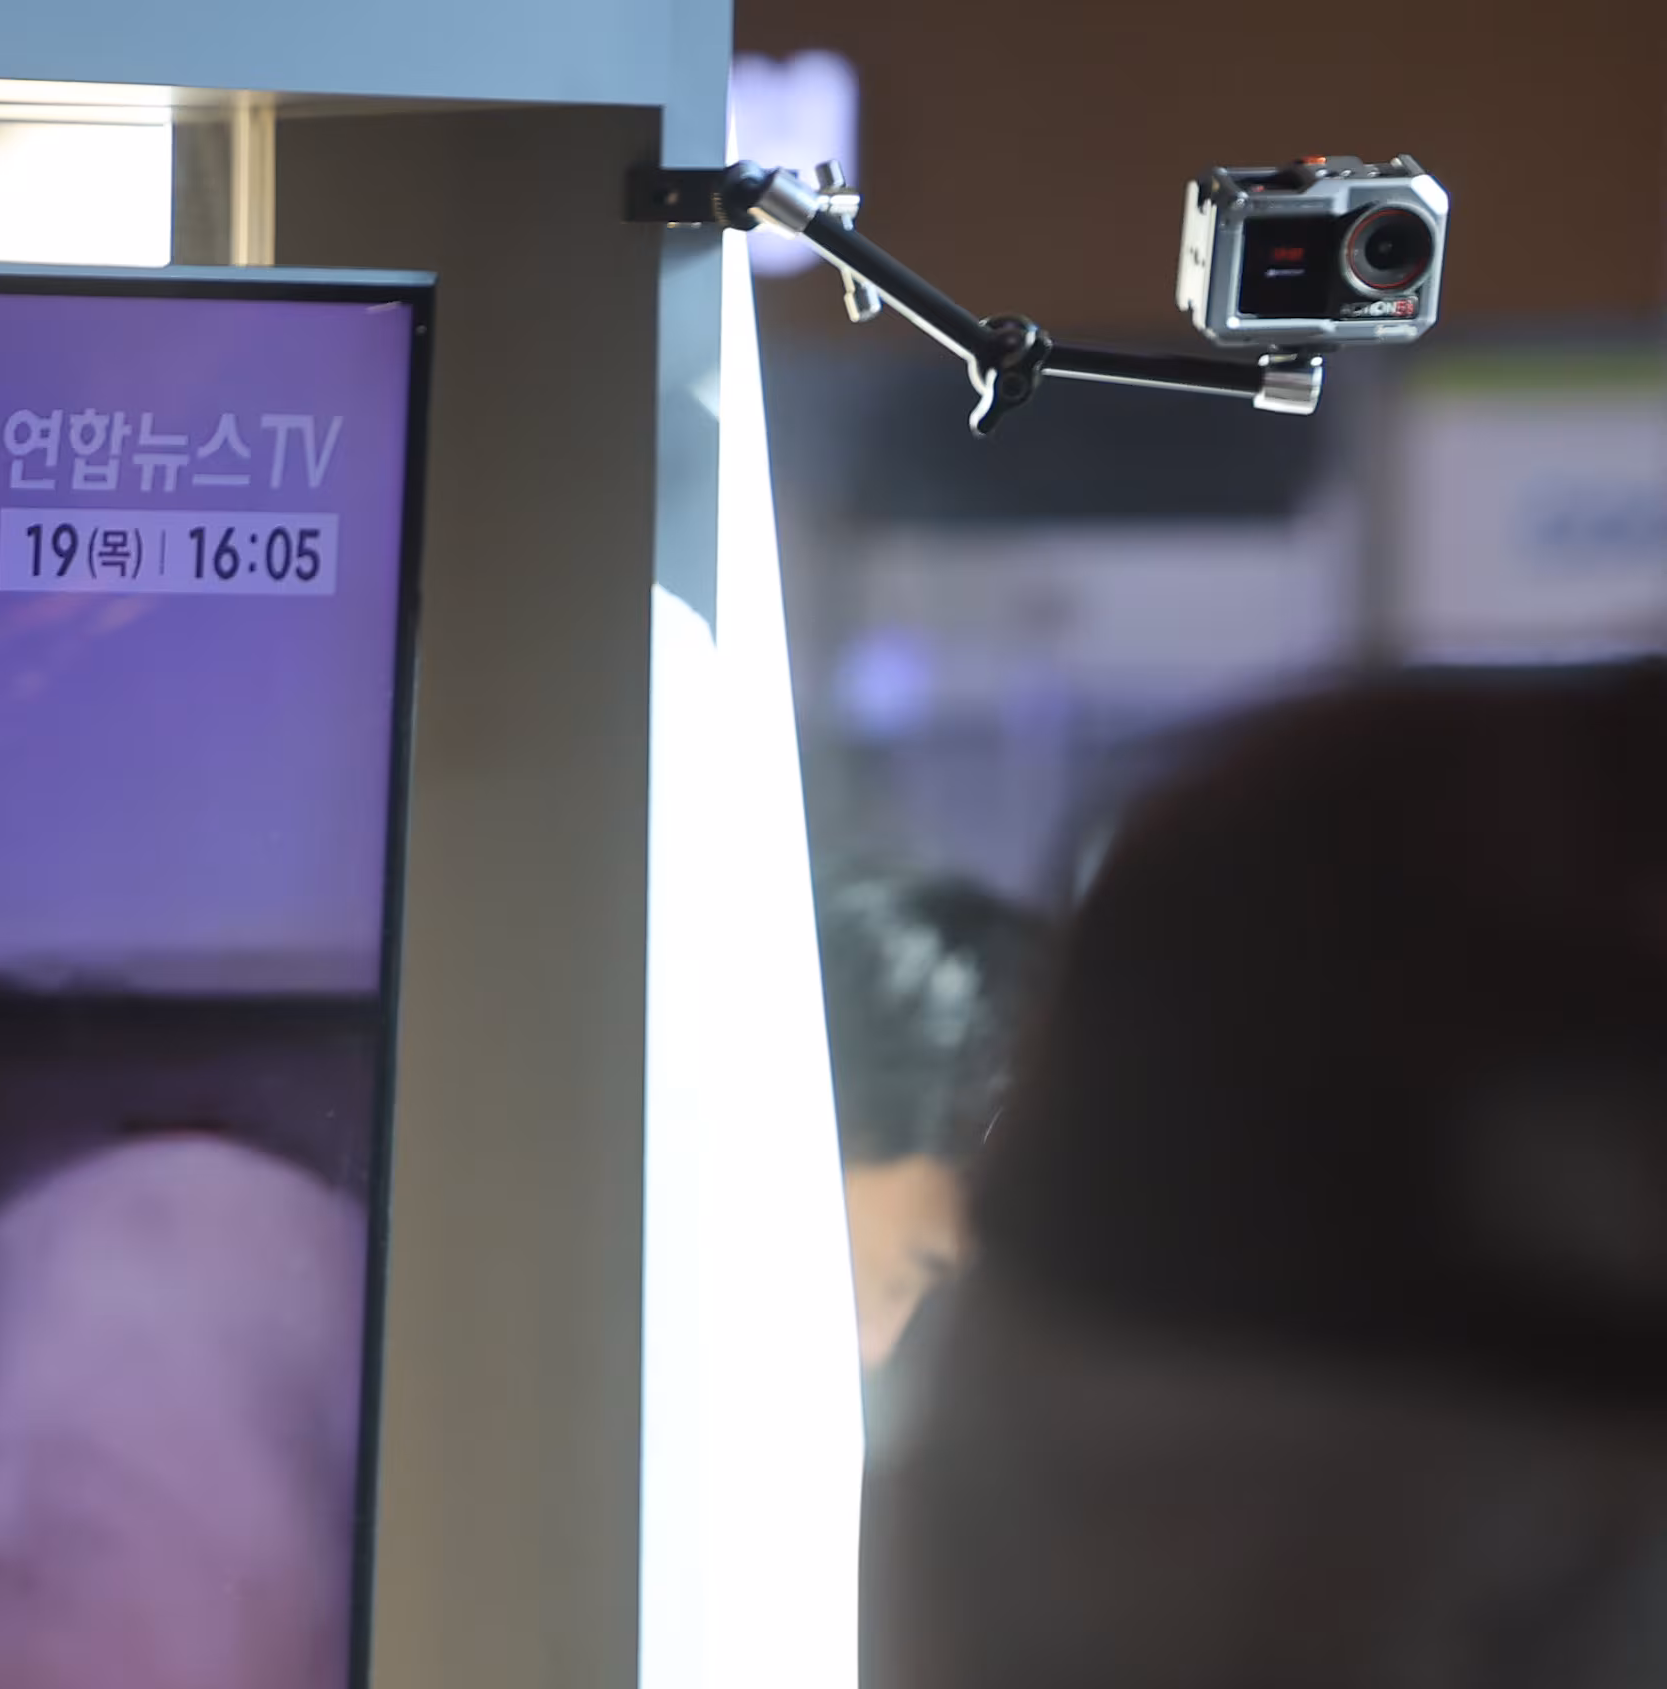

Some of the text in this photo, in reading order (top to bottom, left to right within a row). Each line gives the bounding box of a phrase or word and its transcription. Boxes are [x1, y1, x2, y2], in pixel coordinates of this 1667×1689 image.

[3, 407, 344, 492] 연합뉴스TV
[26, 523, 321, 581] 19(목) 16:05
